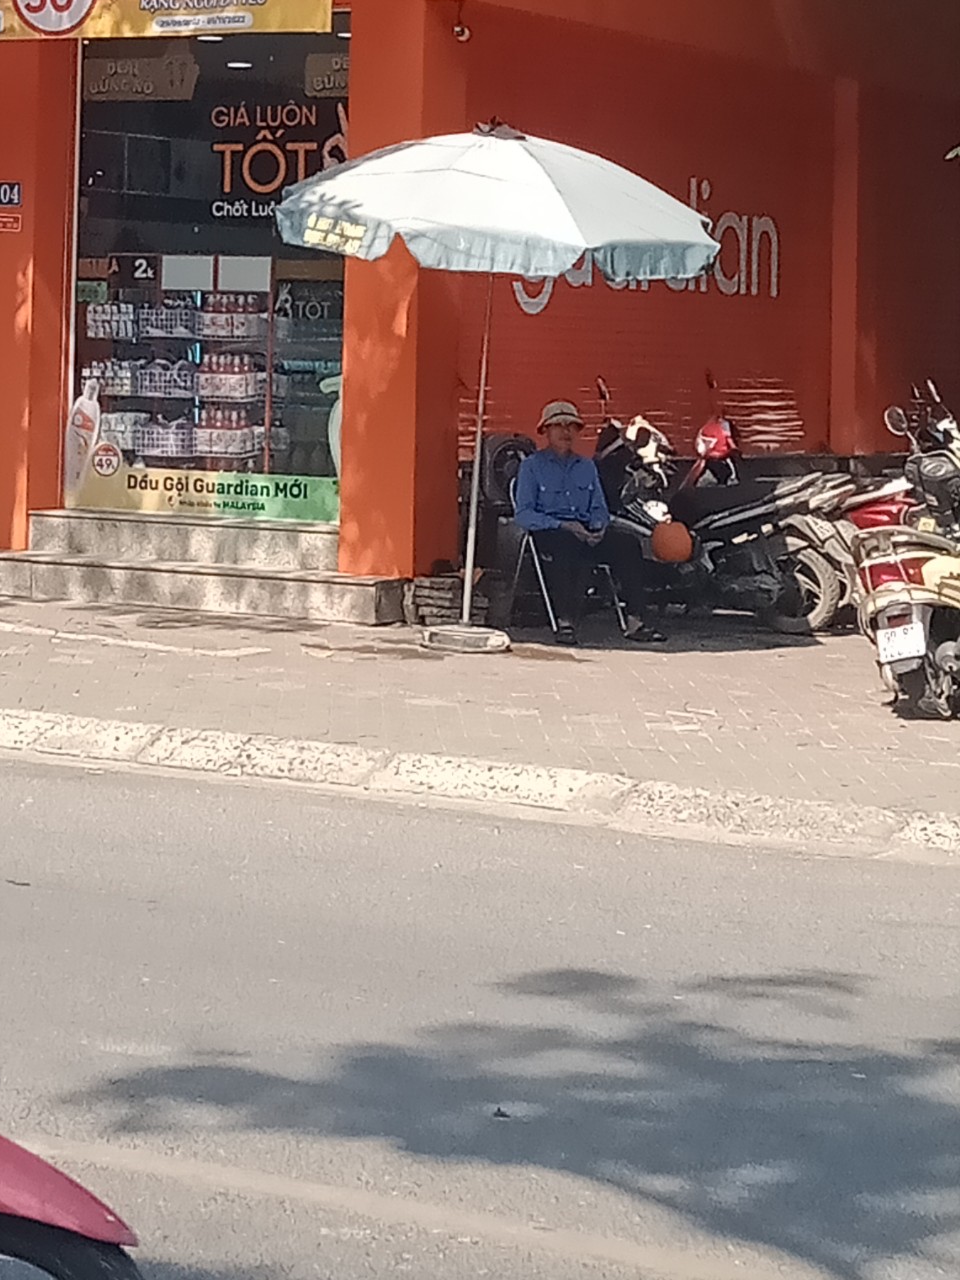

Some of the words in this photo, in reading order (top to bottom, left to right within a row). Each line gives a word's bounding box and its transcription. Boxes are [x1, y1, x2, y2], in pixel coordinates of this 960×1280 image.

[211, 100, 250, 127] GIÁ
[256, 99, 316, 126] LUÔN
[212, 129, 318, 194] TỐT
[193, 477, 270, 498] Guardian
[274, 478, 308, 500] MỚI
